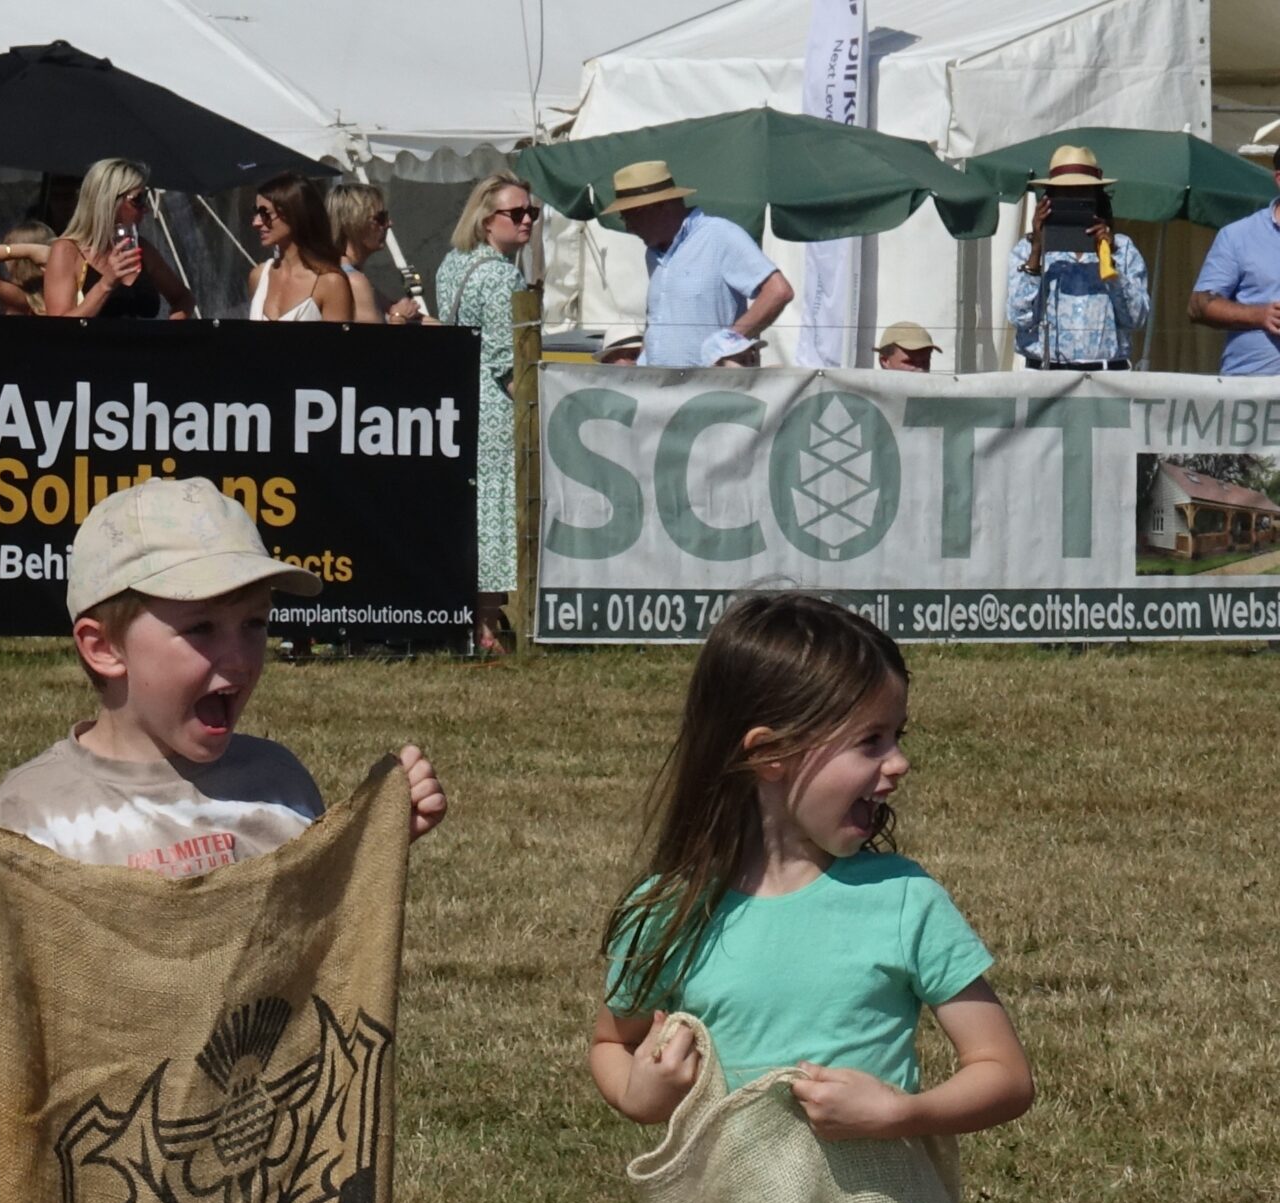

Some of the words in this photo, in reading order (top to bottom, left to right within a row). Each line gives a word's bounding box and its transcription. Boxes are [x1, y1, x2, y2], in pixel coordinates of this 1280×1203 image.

[828, 40, 844, 79] Next
[825, 84, 835, 121] Leve
[294, 386, 460, 458] Plant
[545, 387, 1131, 562] SCOTT
[0, 543, 74, 580] Behi
[545, 594, 583, 631] Tel
[606, 594, 686, 632] 01603
[913, 593, 1201, 632] sales@scottsheds.com
